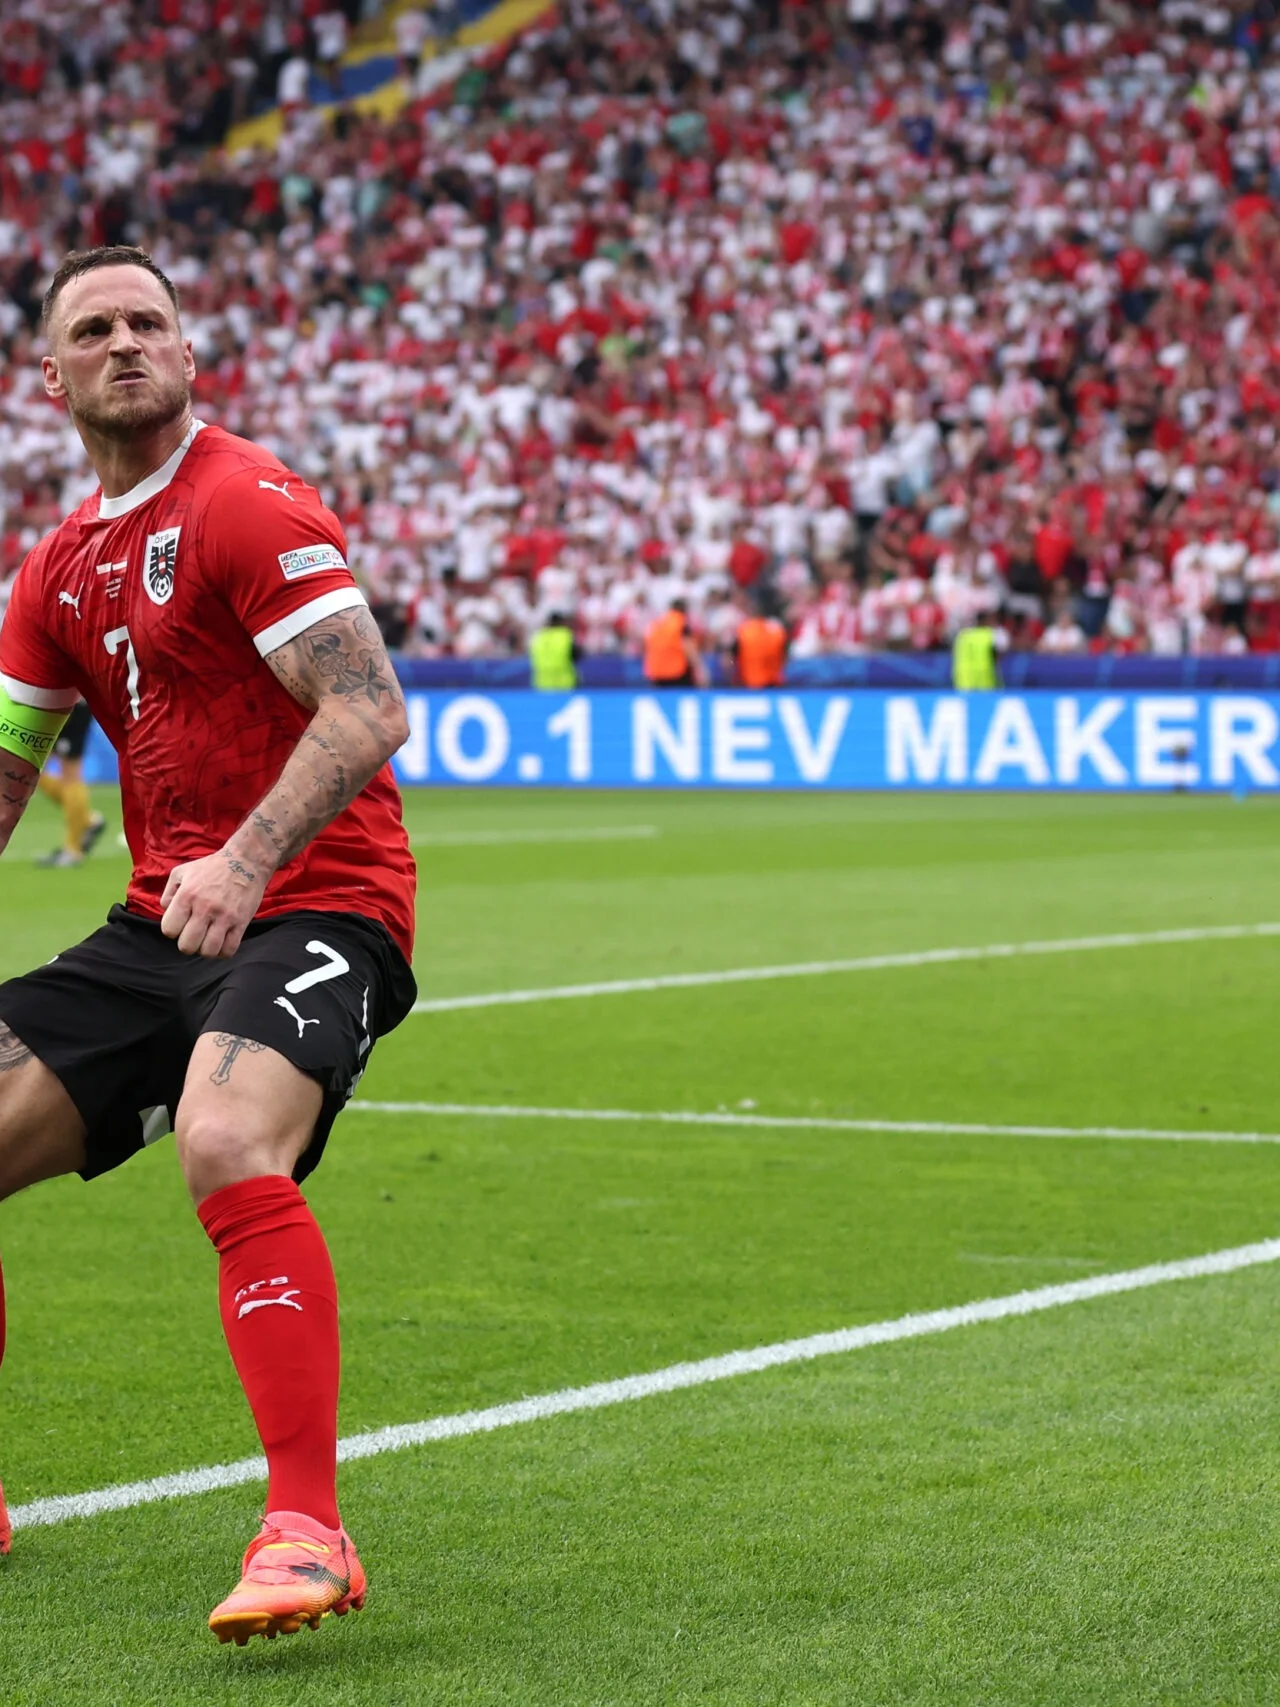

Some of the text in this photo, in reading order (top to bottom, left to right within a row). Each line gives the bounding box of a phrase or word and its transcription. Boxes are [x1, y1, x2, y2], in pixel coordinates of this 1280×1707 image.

[280, 552, 298, 562] UEFA
[283, 551, 341, 571] FOUNDATIO
[103, 624, 141, 721] 7
[0, 722, 54, 749] RESPECT
[631, 695, 851, 782] NEV
[884, 695, 1280, 785] MAKER
[284, 939, 351, 995] 7
